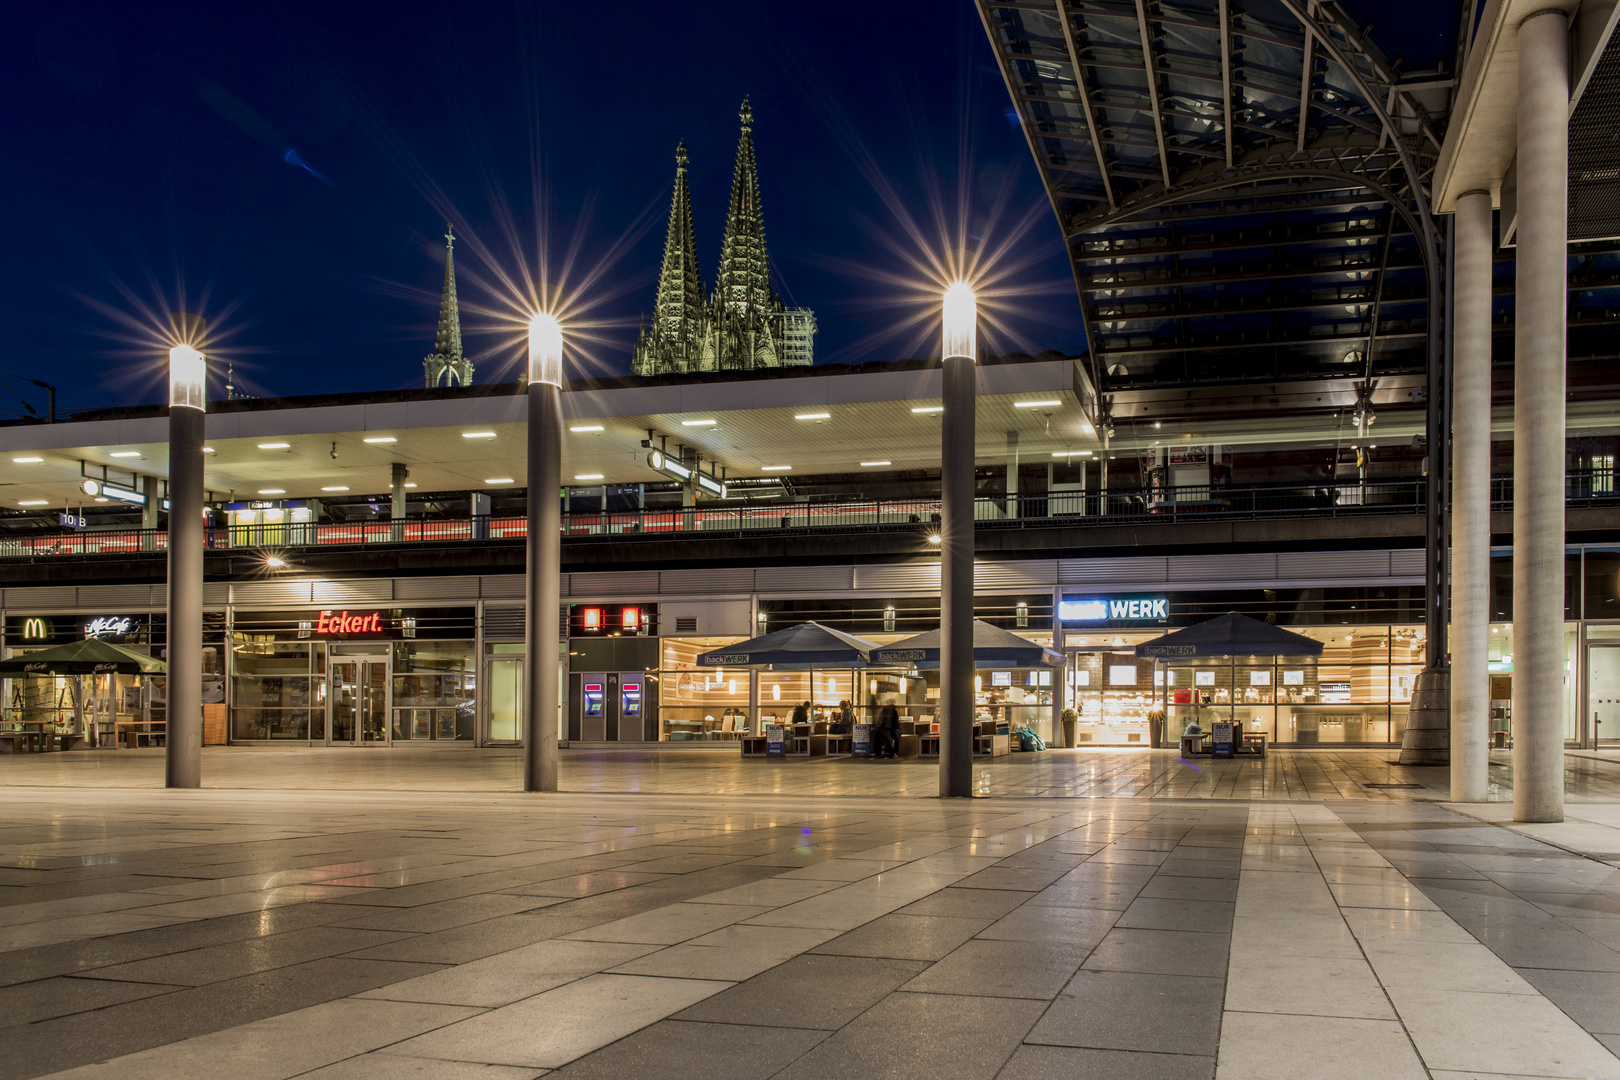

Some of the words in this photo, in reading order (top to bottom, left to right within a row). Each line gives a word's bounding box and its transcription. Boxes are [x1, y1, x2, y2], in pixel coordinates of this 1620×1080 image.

[62, 514, 74, 525] 10
[79, 516, 87, 527] B
[317, 610, 383, 633] Eckert.
